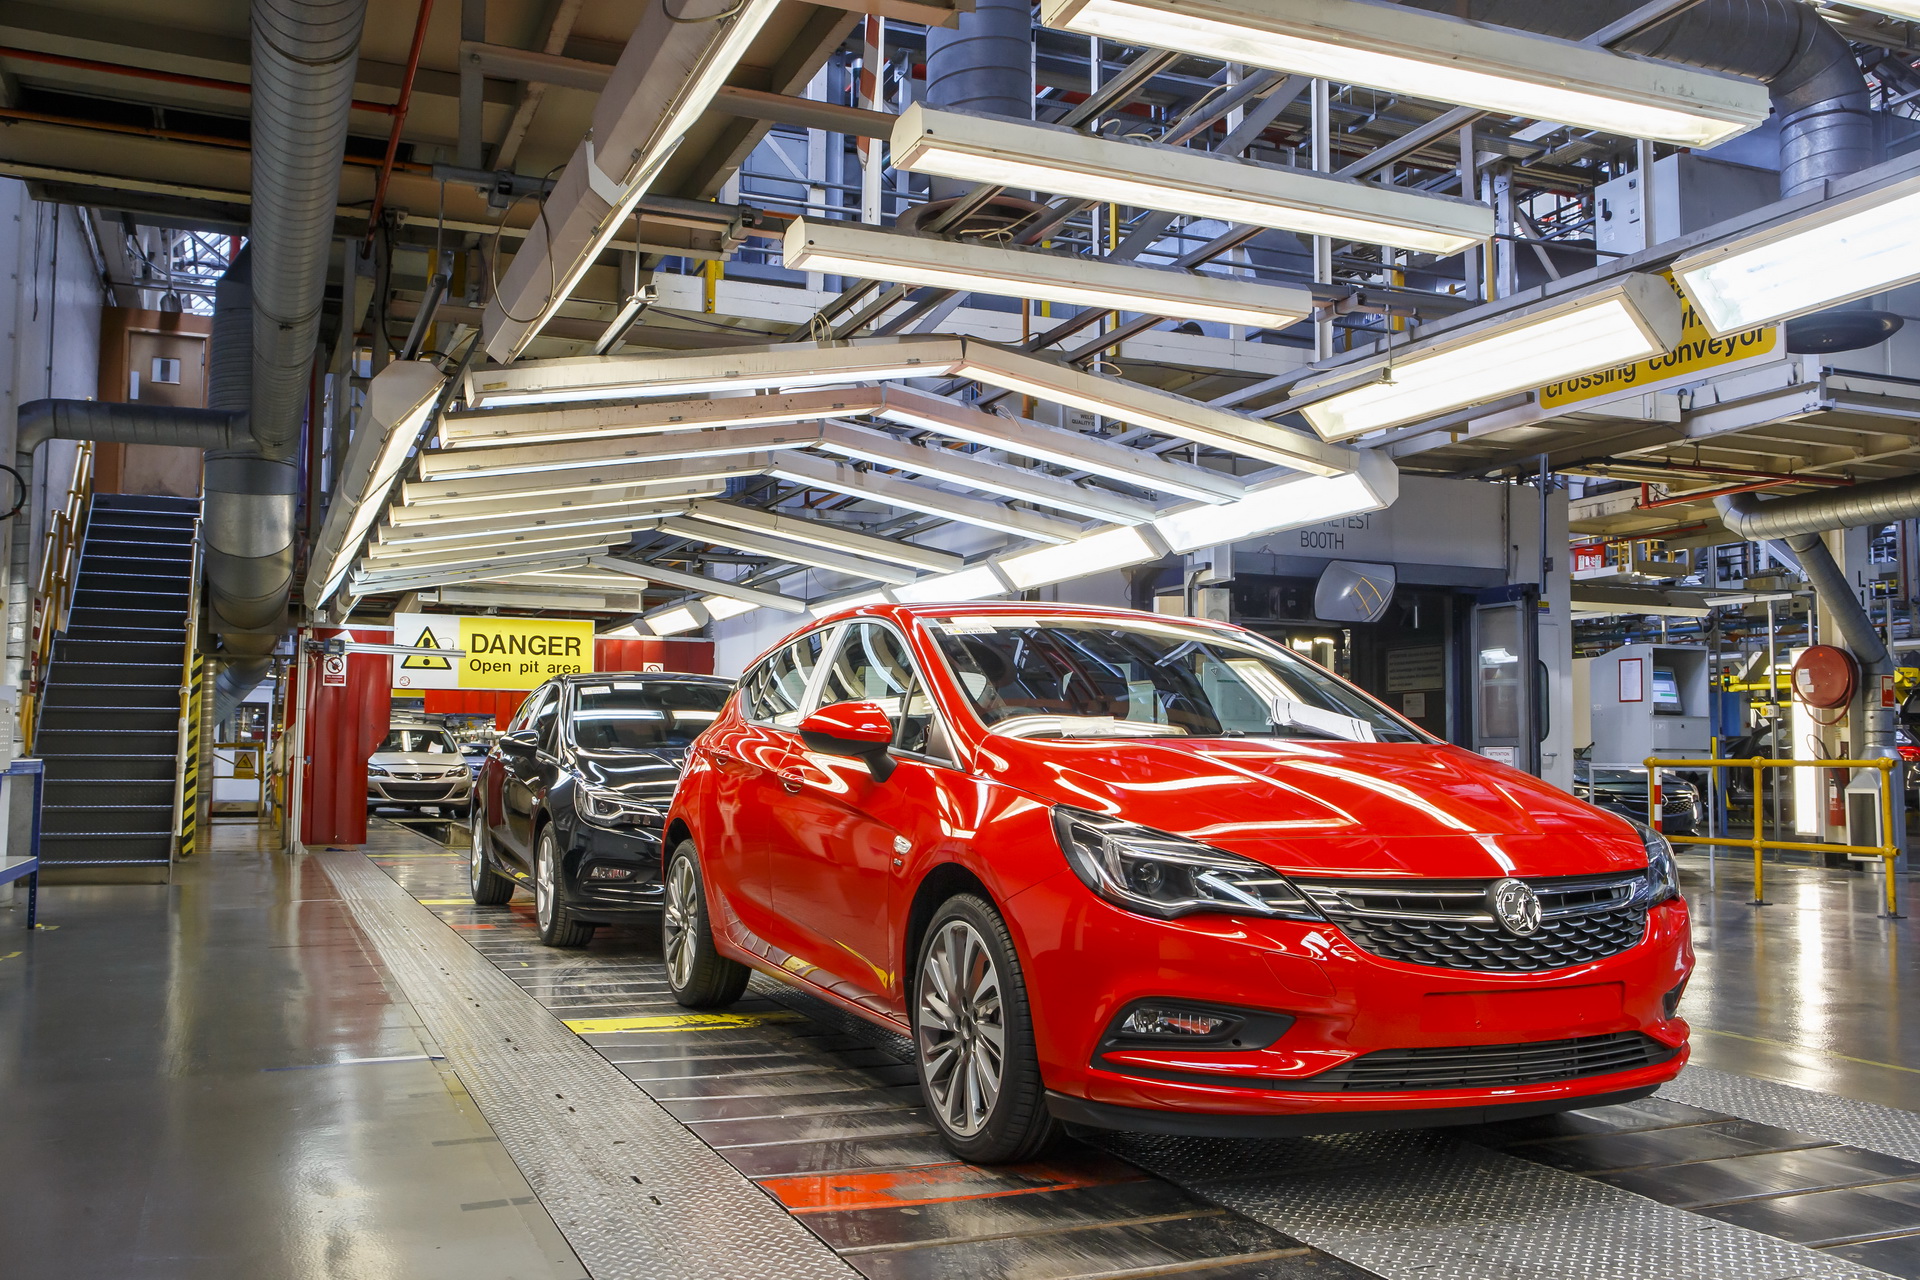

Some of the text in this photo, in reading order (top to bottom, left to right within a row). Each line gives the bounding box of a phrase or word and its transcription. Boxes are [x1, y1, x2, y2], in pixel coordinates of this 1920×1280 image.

[1546, 328, 1763, 398] crossing conveyor
[1300, 530, 1345, 550] BOOTH
[471, 633, 582, 657] DANGER
[469, 658, 582, 676] Open pit area
